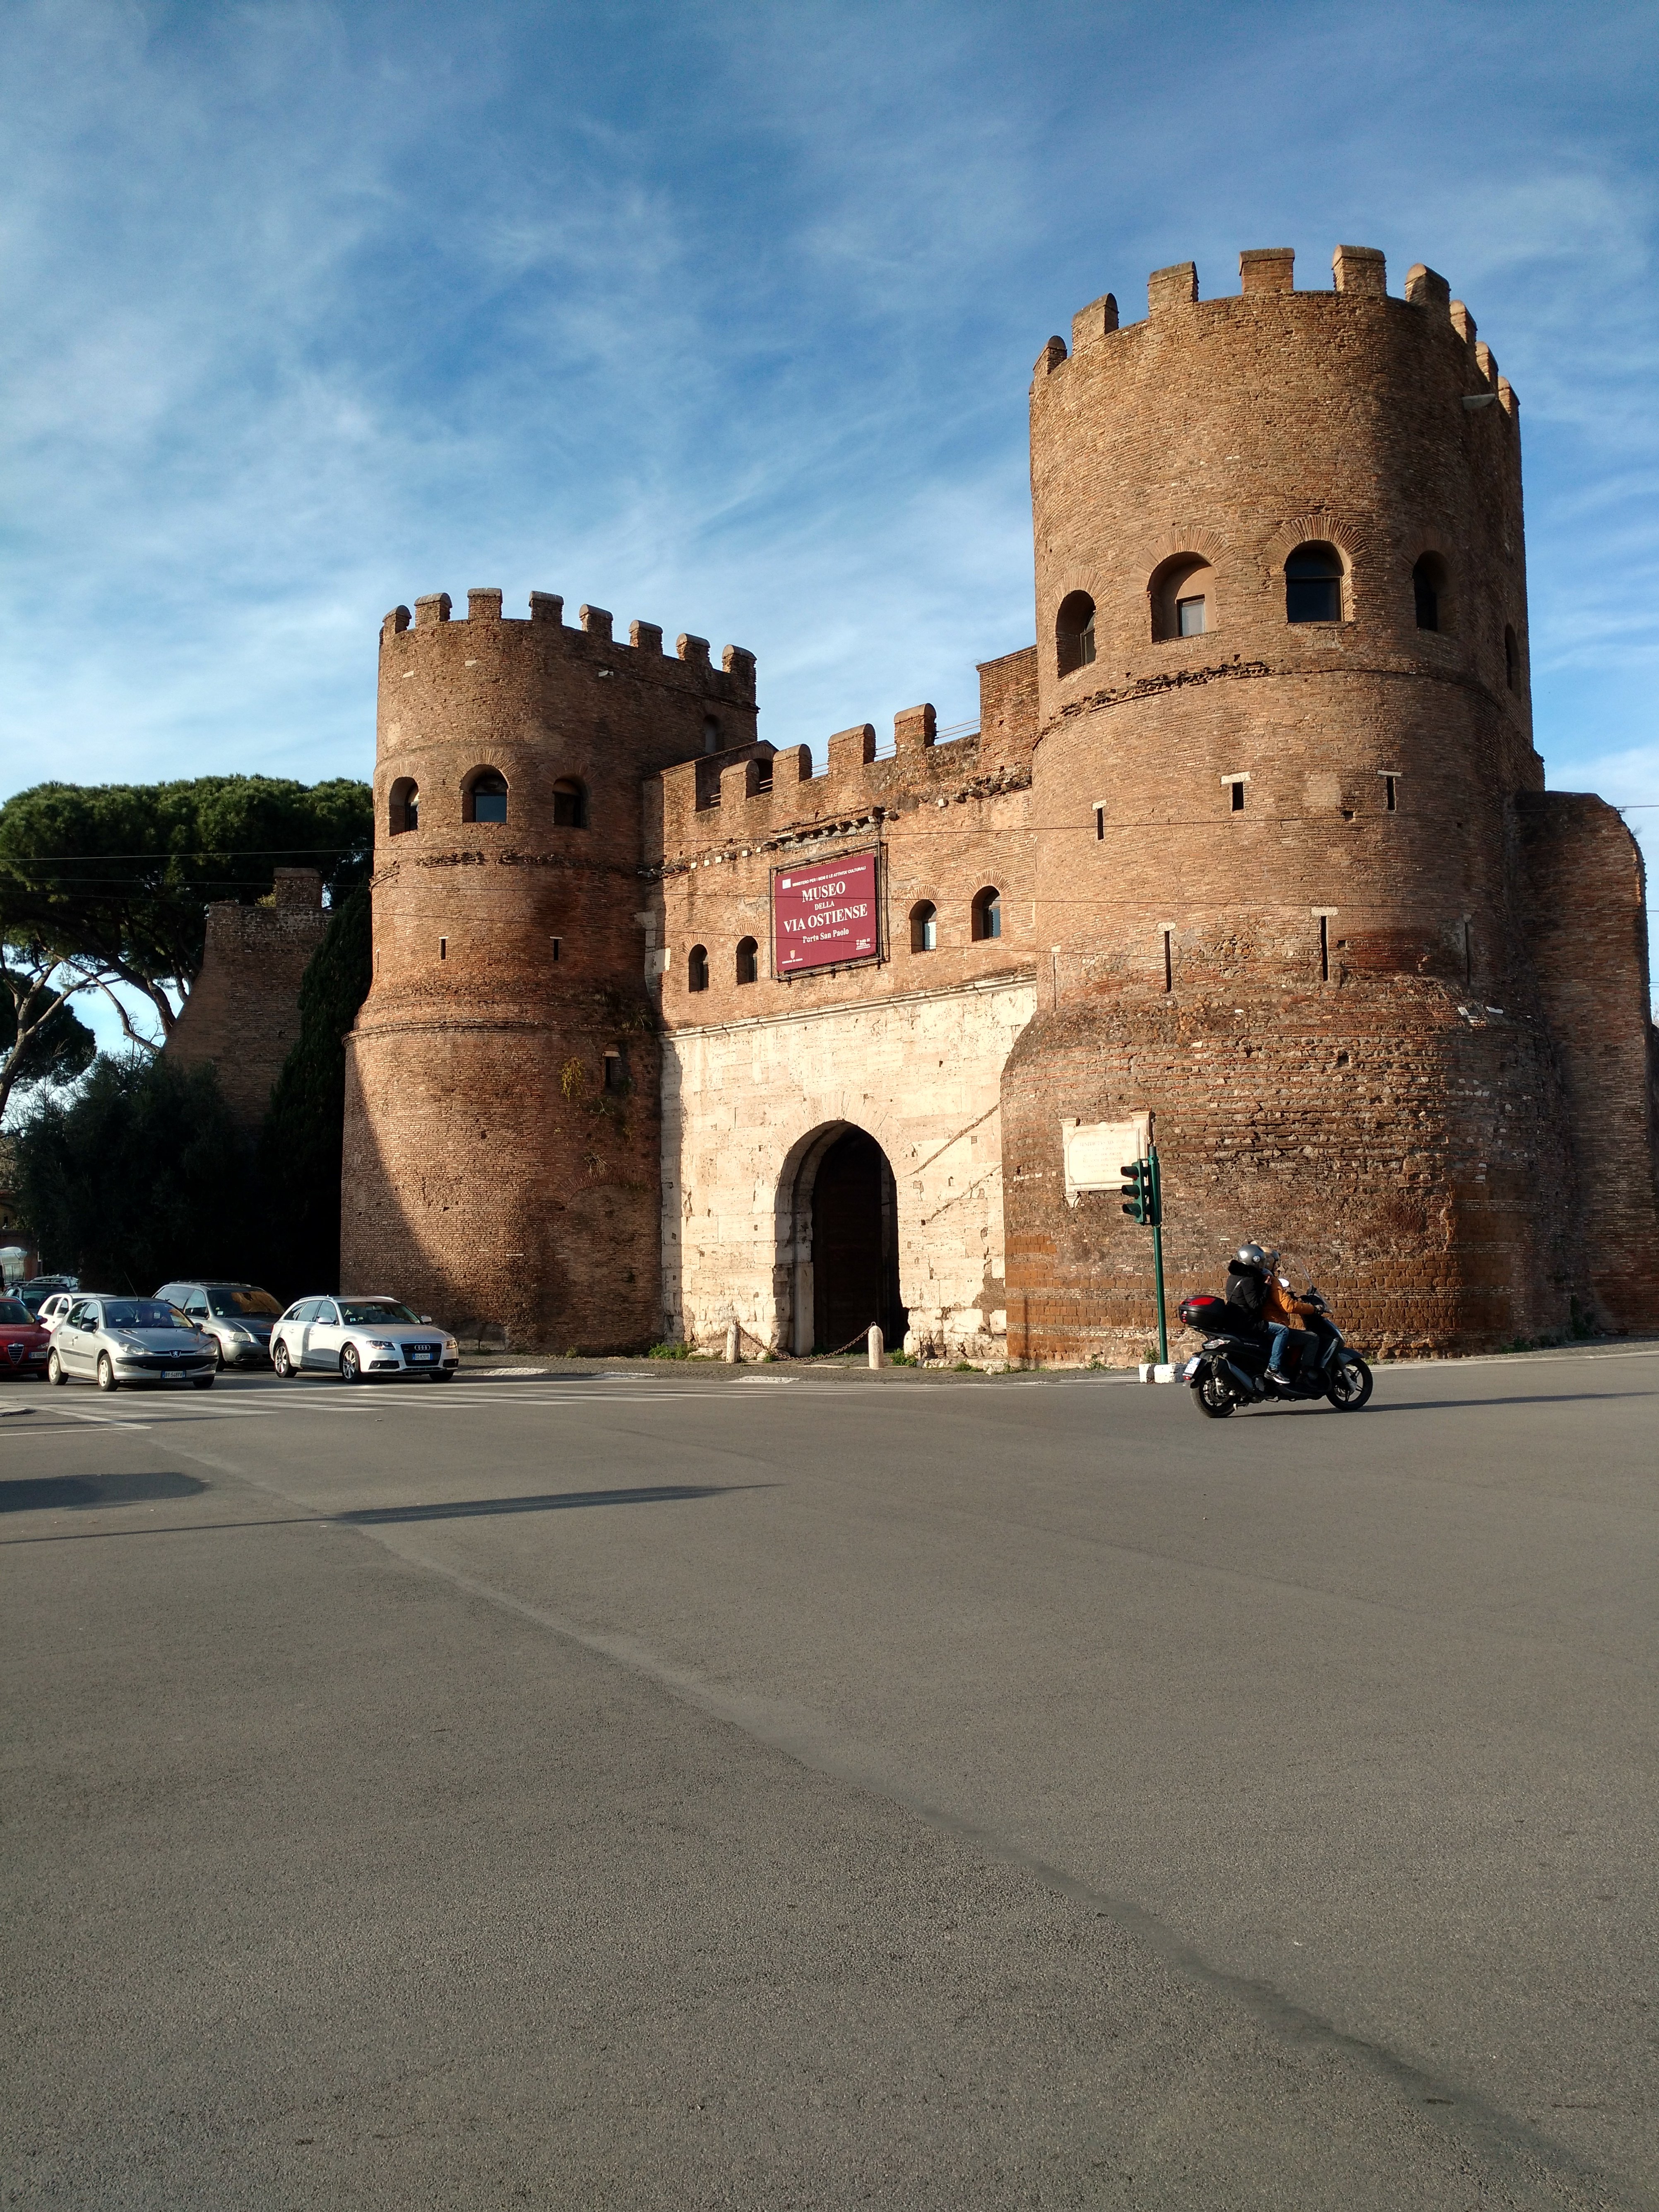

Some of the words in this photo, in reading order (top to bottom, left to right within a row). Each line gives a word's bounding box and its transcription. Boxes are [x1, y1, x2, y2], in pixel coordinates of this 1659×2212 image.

[848, 866, 866, 874] CULTURALI
[802, 881, 846, 902] MUSEO
[815, 900, 835, 910] DELLA
[783, 918, 806, 933] VIA
[808, 904, 868, 928] OSTIENSE
[802, 935, 819, 944] Porta
[820, 932, 832, 940] San
[832, 928, 849, 938] Paolo
